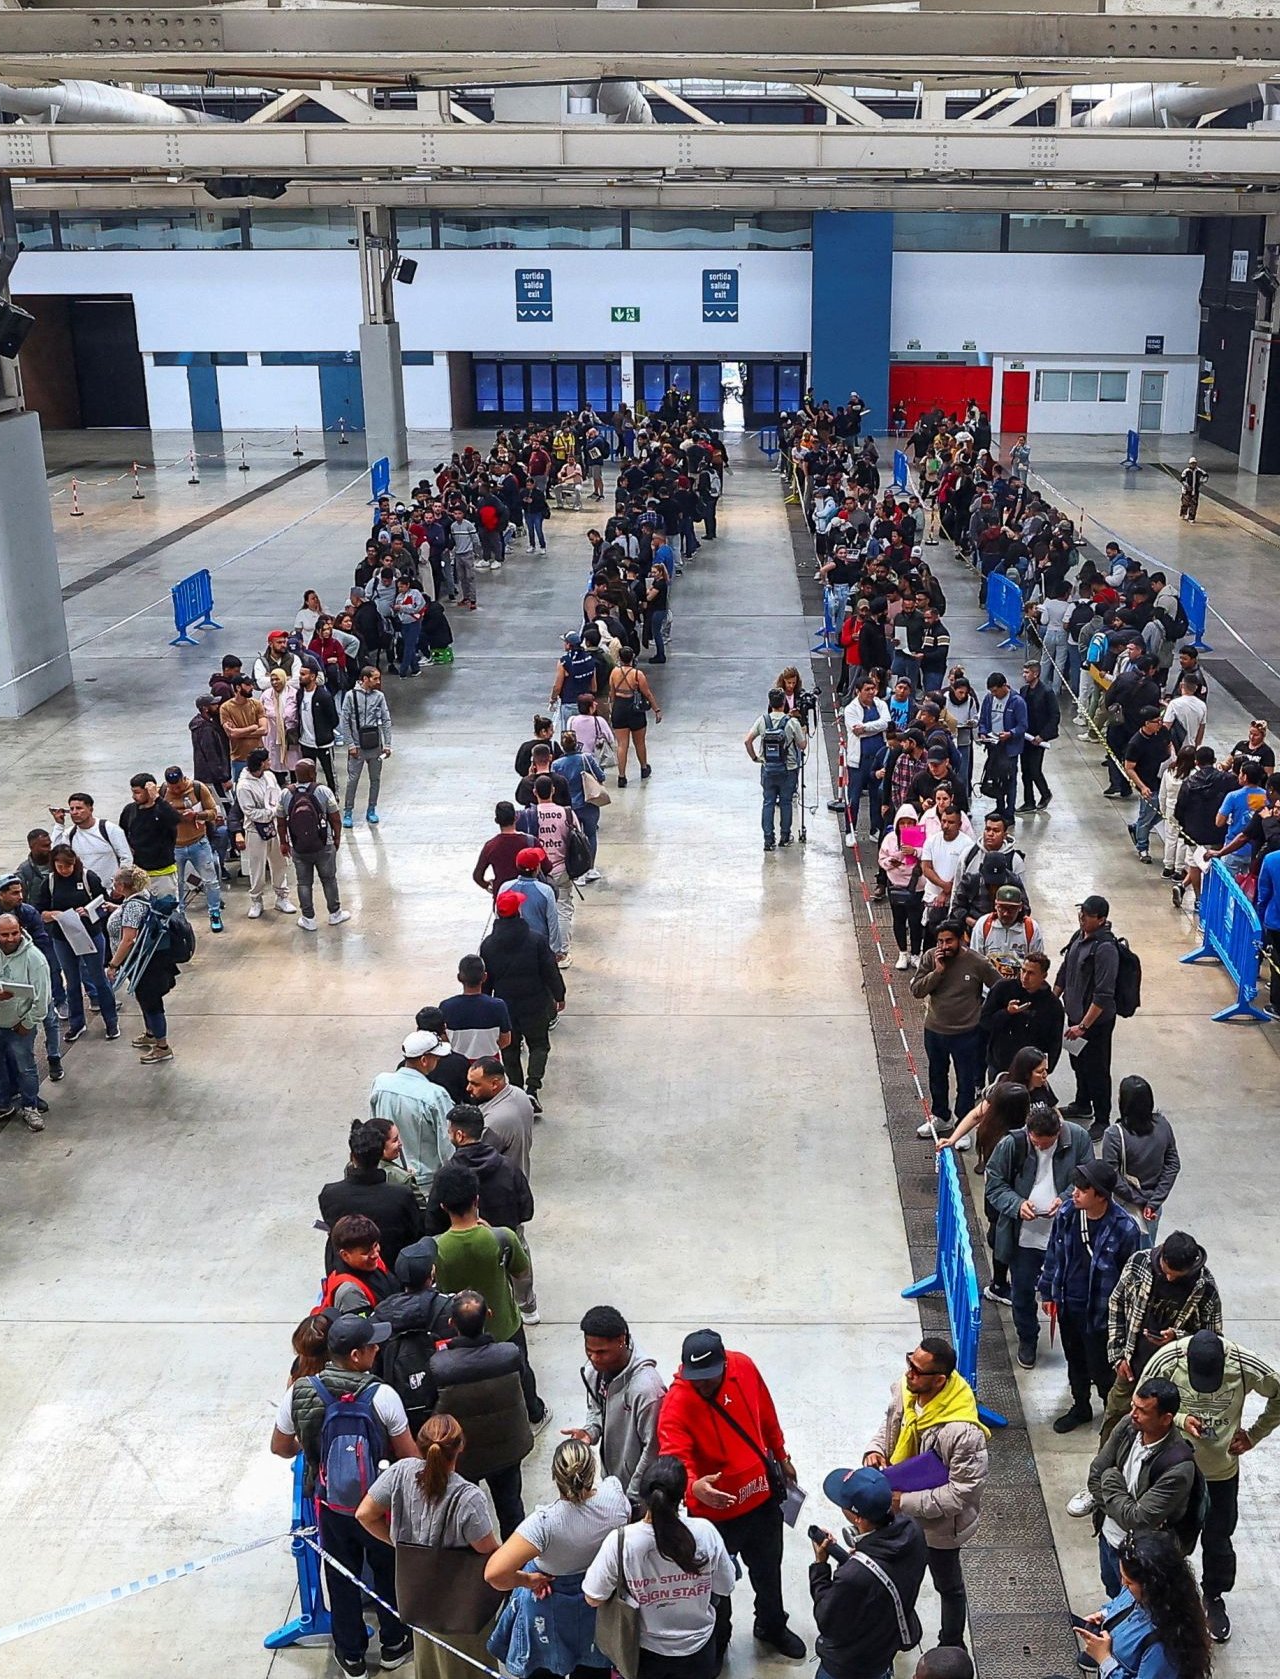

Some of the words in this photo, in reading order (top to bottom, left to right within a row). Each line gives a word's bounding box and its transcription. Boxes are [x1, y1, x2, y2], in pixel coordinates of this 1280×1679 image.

[522, 272, 544, 280] sortida
[709, 273, 731, 281] sortida
[523, 281, 543, 289] salida
[710, 282, 730, 290] salida
[527, 290, 540, 298] exit
[714, 291, 726, 299] exit
[637, 1590, 670, 1605] SIGN
[672, 1583, 711, 1597] STAFF
